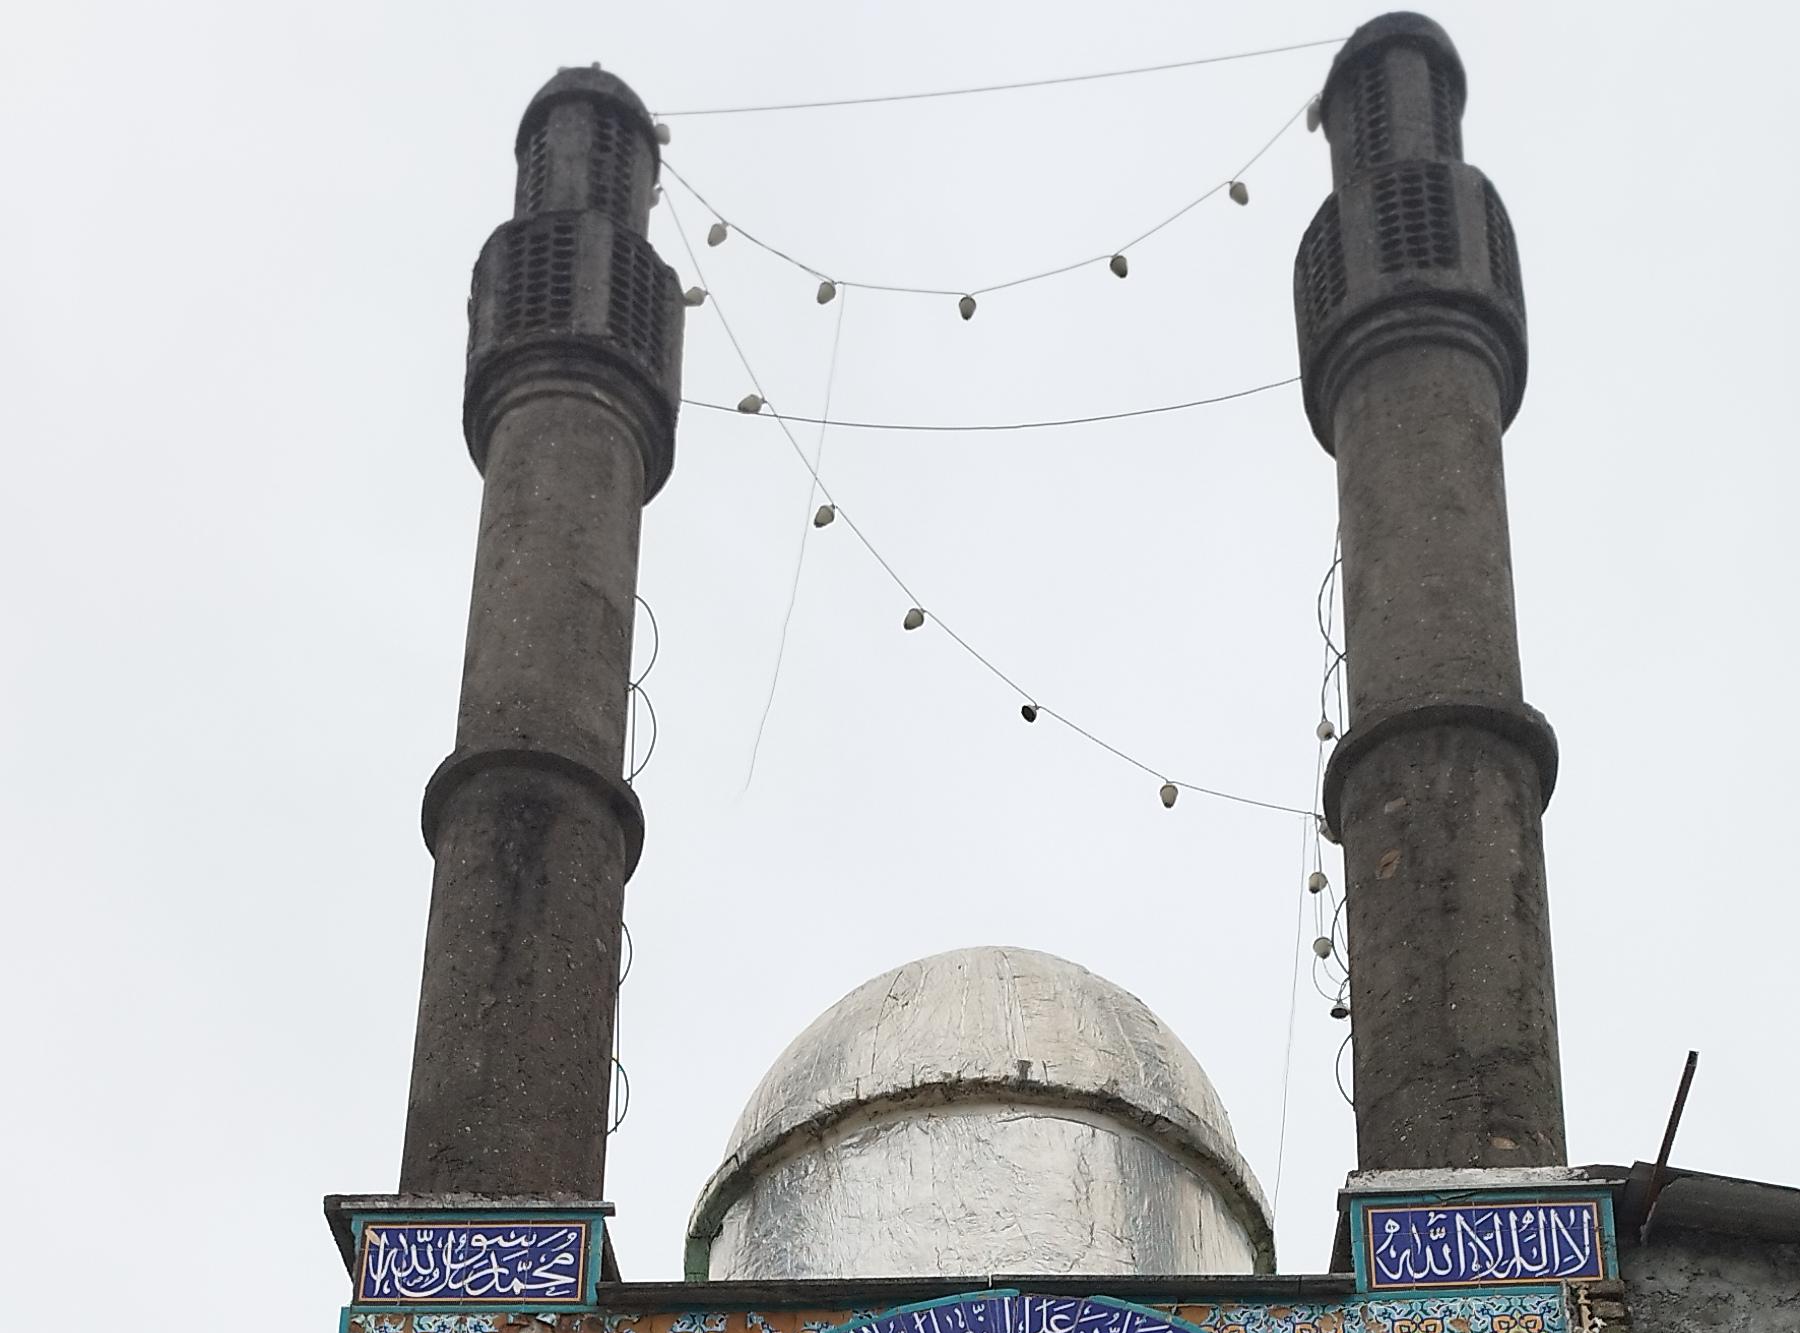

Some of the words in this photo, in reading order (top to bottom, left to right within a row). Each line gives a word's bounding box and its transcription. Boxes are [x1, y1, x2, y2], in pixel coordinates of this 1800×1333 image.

[463, 1230, 578, 1297] محمد
[1376, 1211, 1466, 1281] الله
[1552, 1208, 1592, 1277] لا
